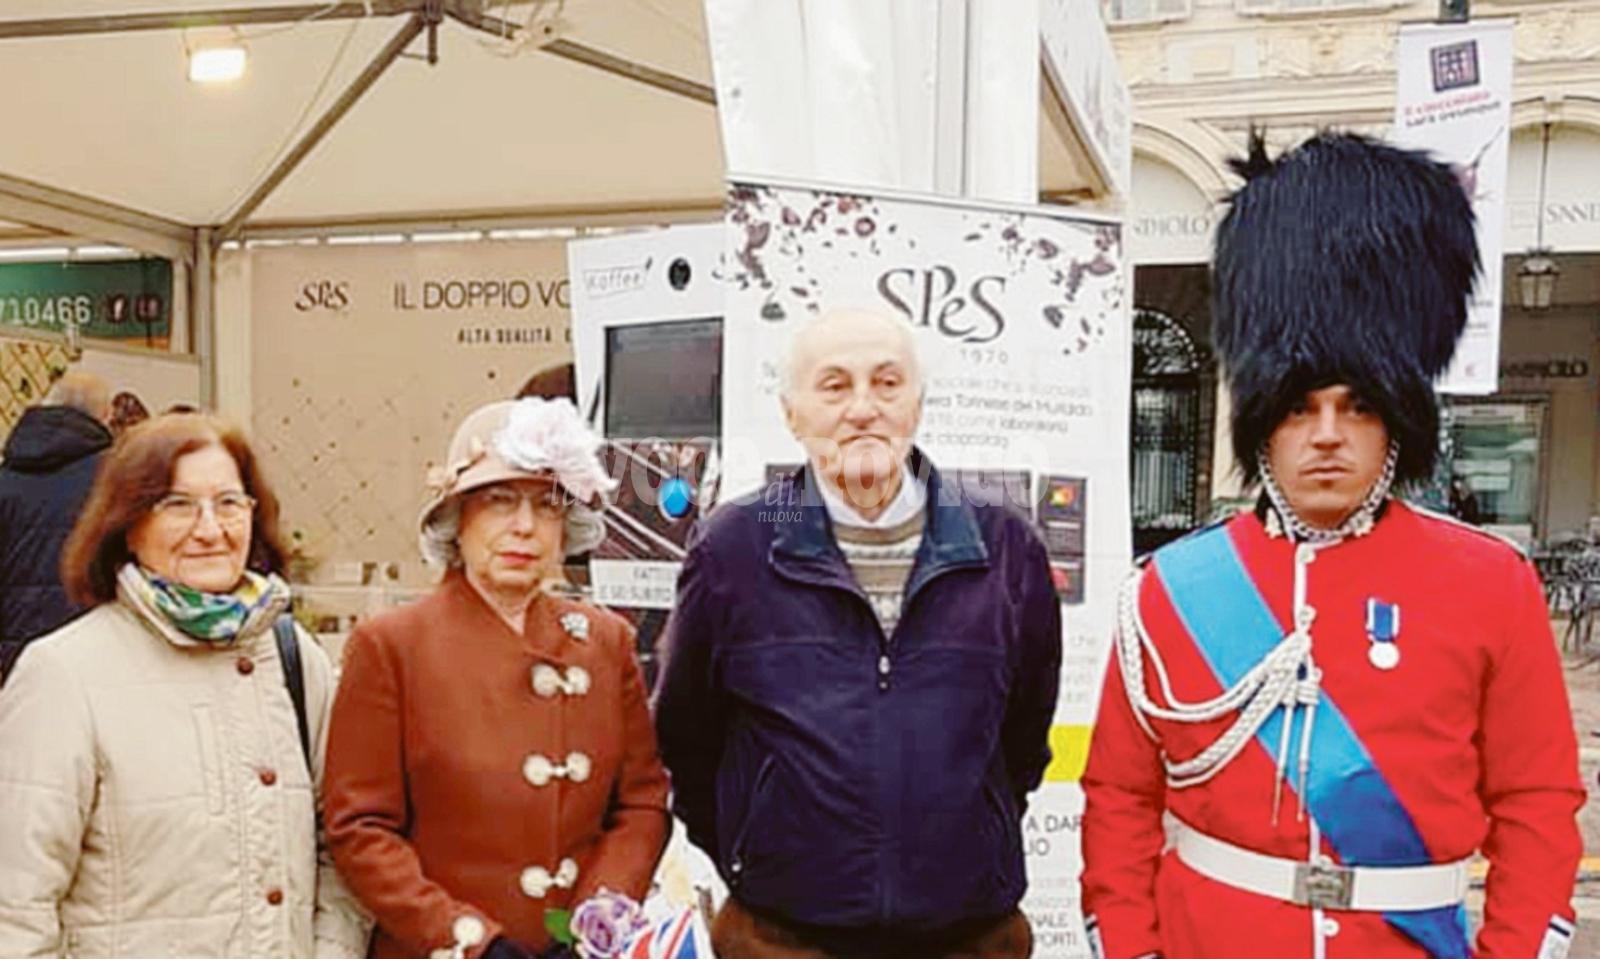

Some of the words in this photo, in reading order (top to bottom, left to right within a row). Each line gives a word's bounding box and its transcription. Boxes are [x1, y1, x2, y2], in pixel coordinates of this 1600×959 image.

[393, 283, 416, 309] IL
[423, 281, 530, 309] DOPPIO
[960, 350, 1009, 365] 1970
